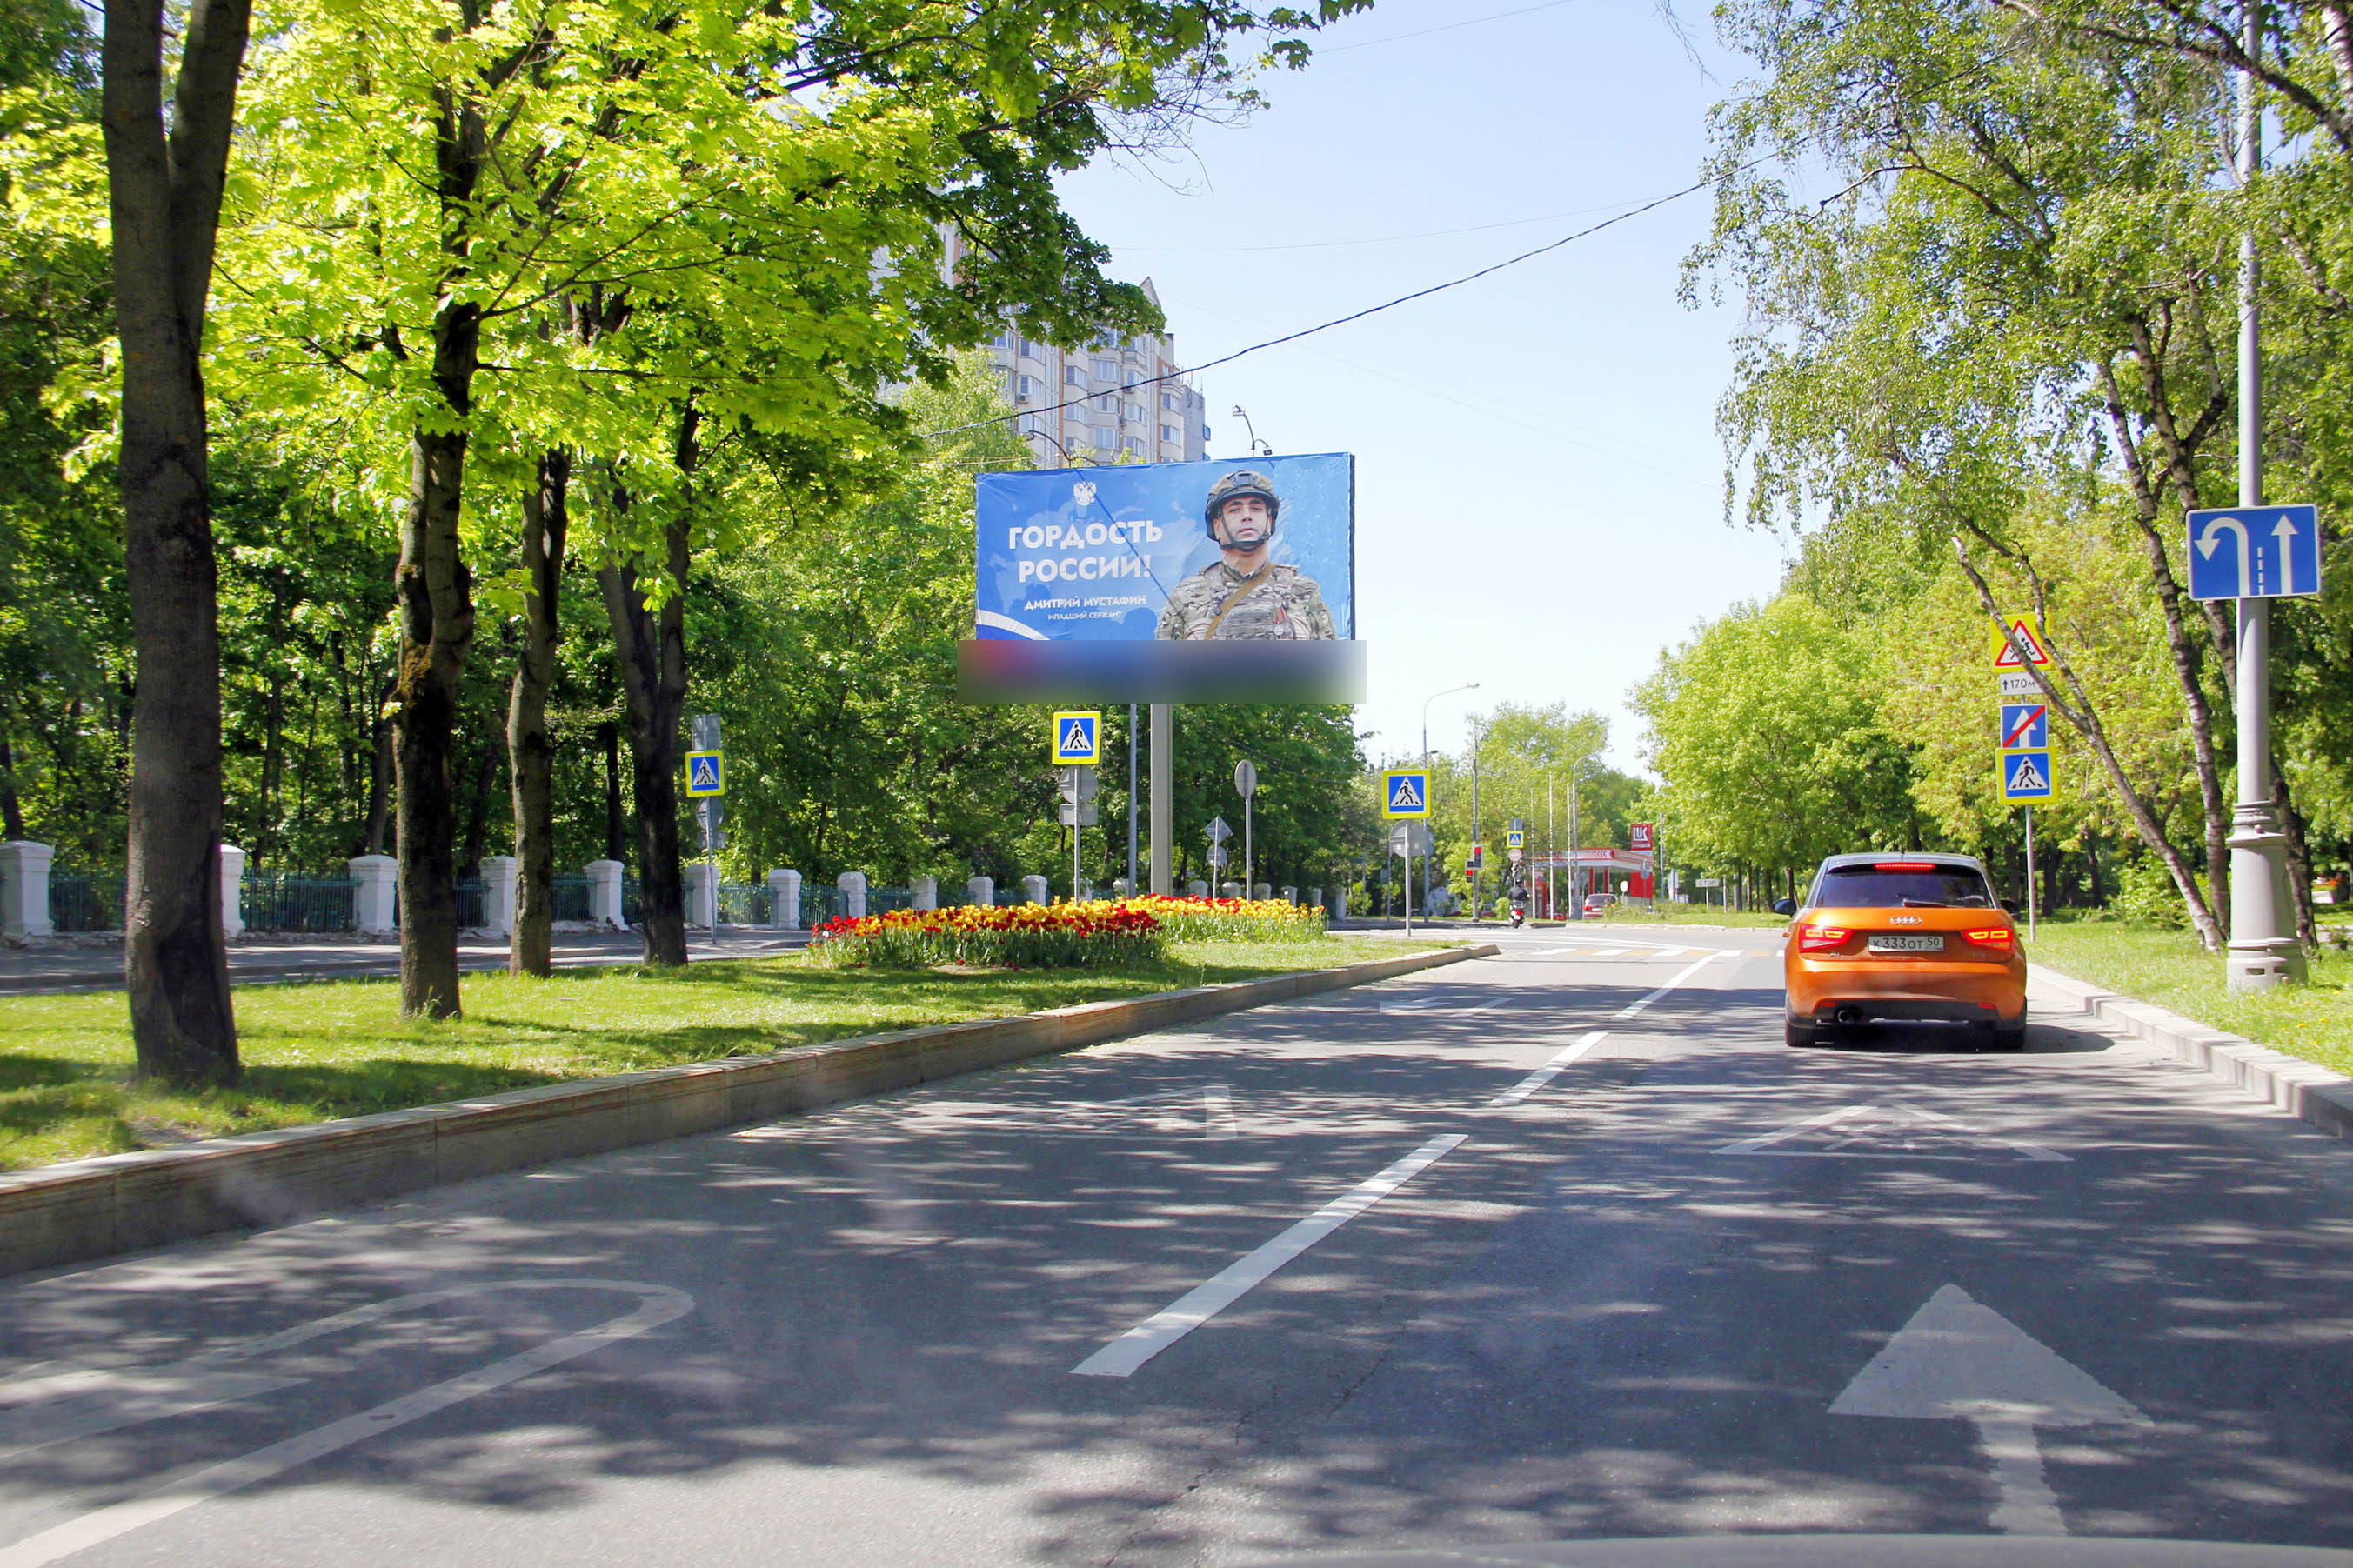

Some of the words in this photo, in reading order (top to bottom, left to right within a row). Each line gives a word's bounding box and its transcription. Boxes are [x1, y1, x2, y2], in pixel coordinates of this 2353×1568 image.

[1008, 520, 1163, 550] ГОРДОСТЬ
[1019, 554, 1152, 583] РОССИИ!
[1024, 595, 1080, 611] ДМИТРИЙ
[1083, 595, 1147, 607] МУСТАФИН
[1047, 611, 1087, 620] МЛАДШИЙ
[1088, 611, 1122, 619] СЕРЖАНТ
